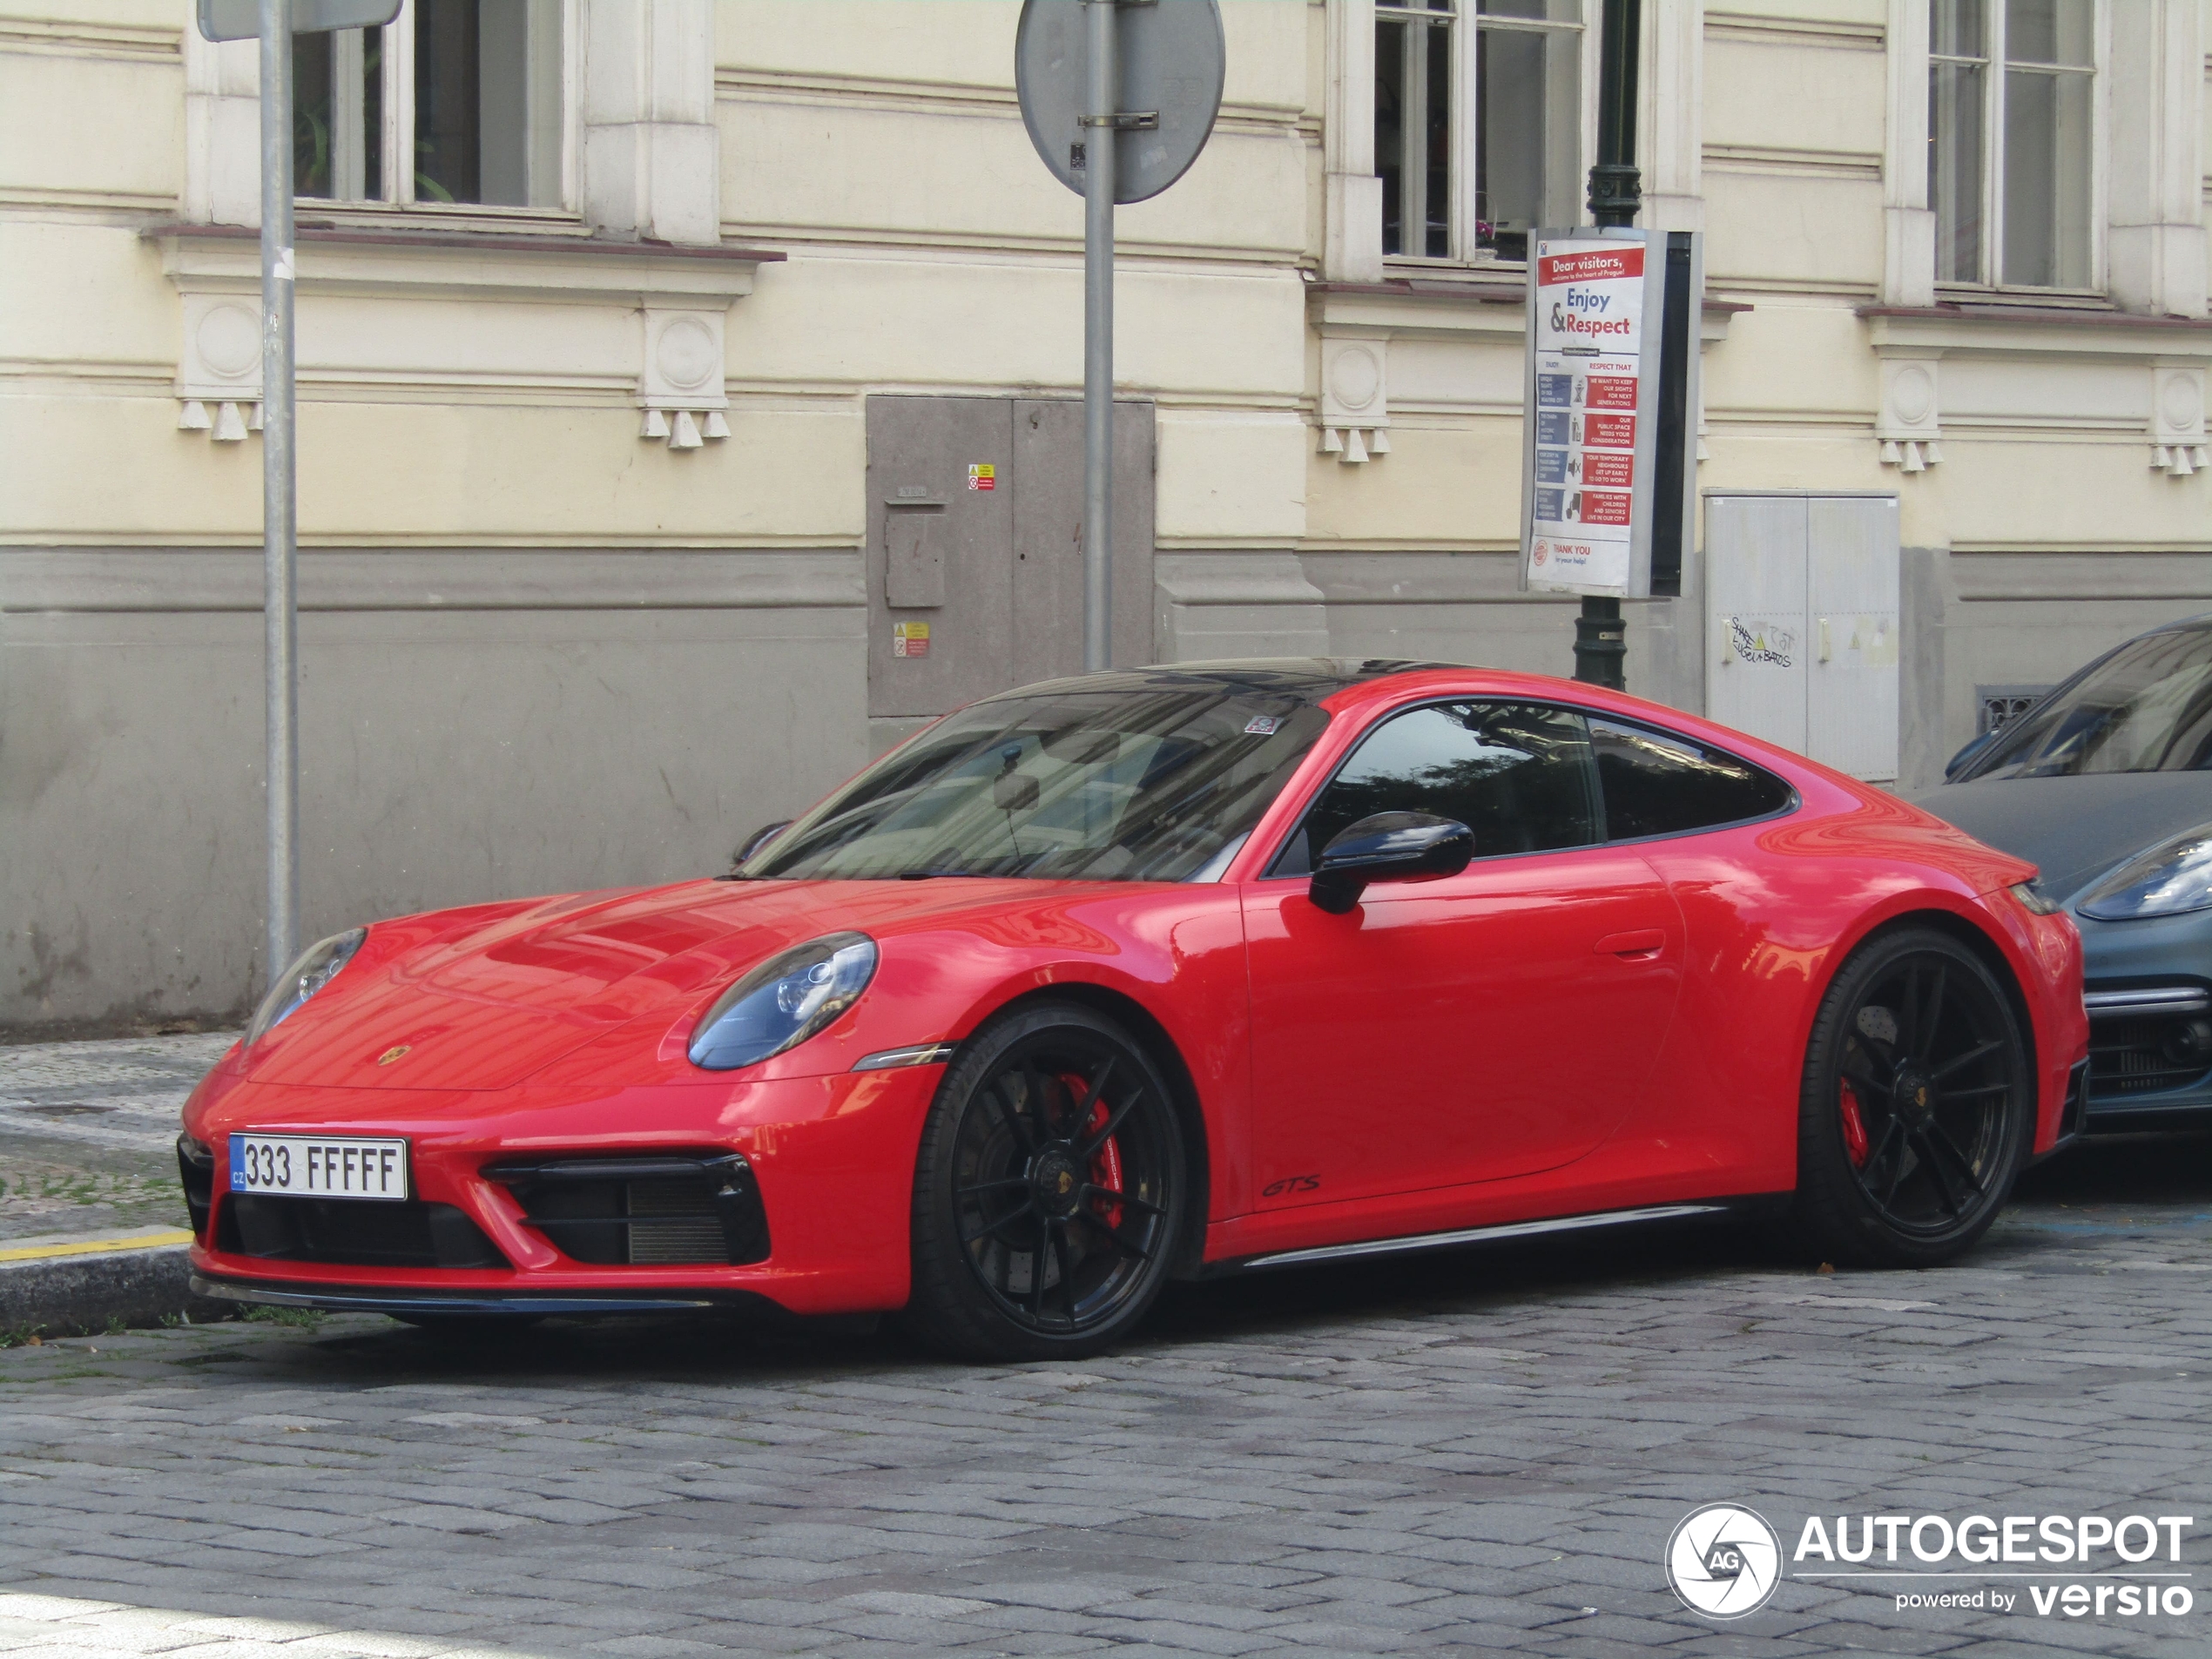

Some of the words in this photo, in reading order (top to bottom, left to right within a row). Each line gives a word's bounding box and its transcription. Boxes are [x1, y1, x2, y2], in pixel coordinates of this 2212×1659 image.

[1553, 260, 1575, 273] Dear
[1578, 256, 1622, 270] visitors,
[1567, 288, 1611, 313] Enjoy
[1551, 302, 1566, 333] &
[1567, 314, 1630, 339] Respect
[1554, 543, 1573, 554] THANK
[1575, 545, 1591, 556] YOU
[246, 1143, 291, 1187] 333
[307, 1146, 397, 1191] FFFFF
[1107, 1136, 1120, 1190] ORSCHE
[233, 1172, 245, 1184] CZ
[1262, 1174, 1321, 1197] GTS
